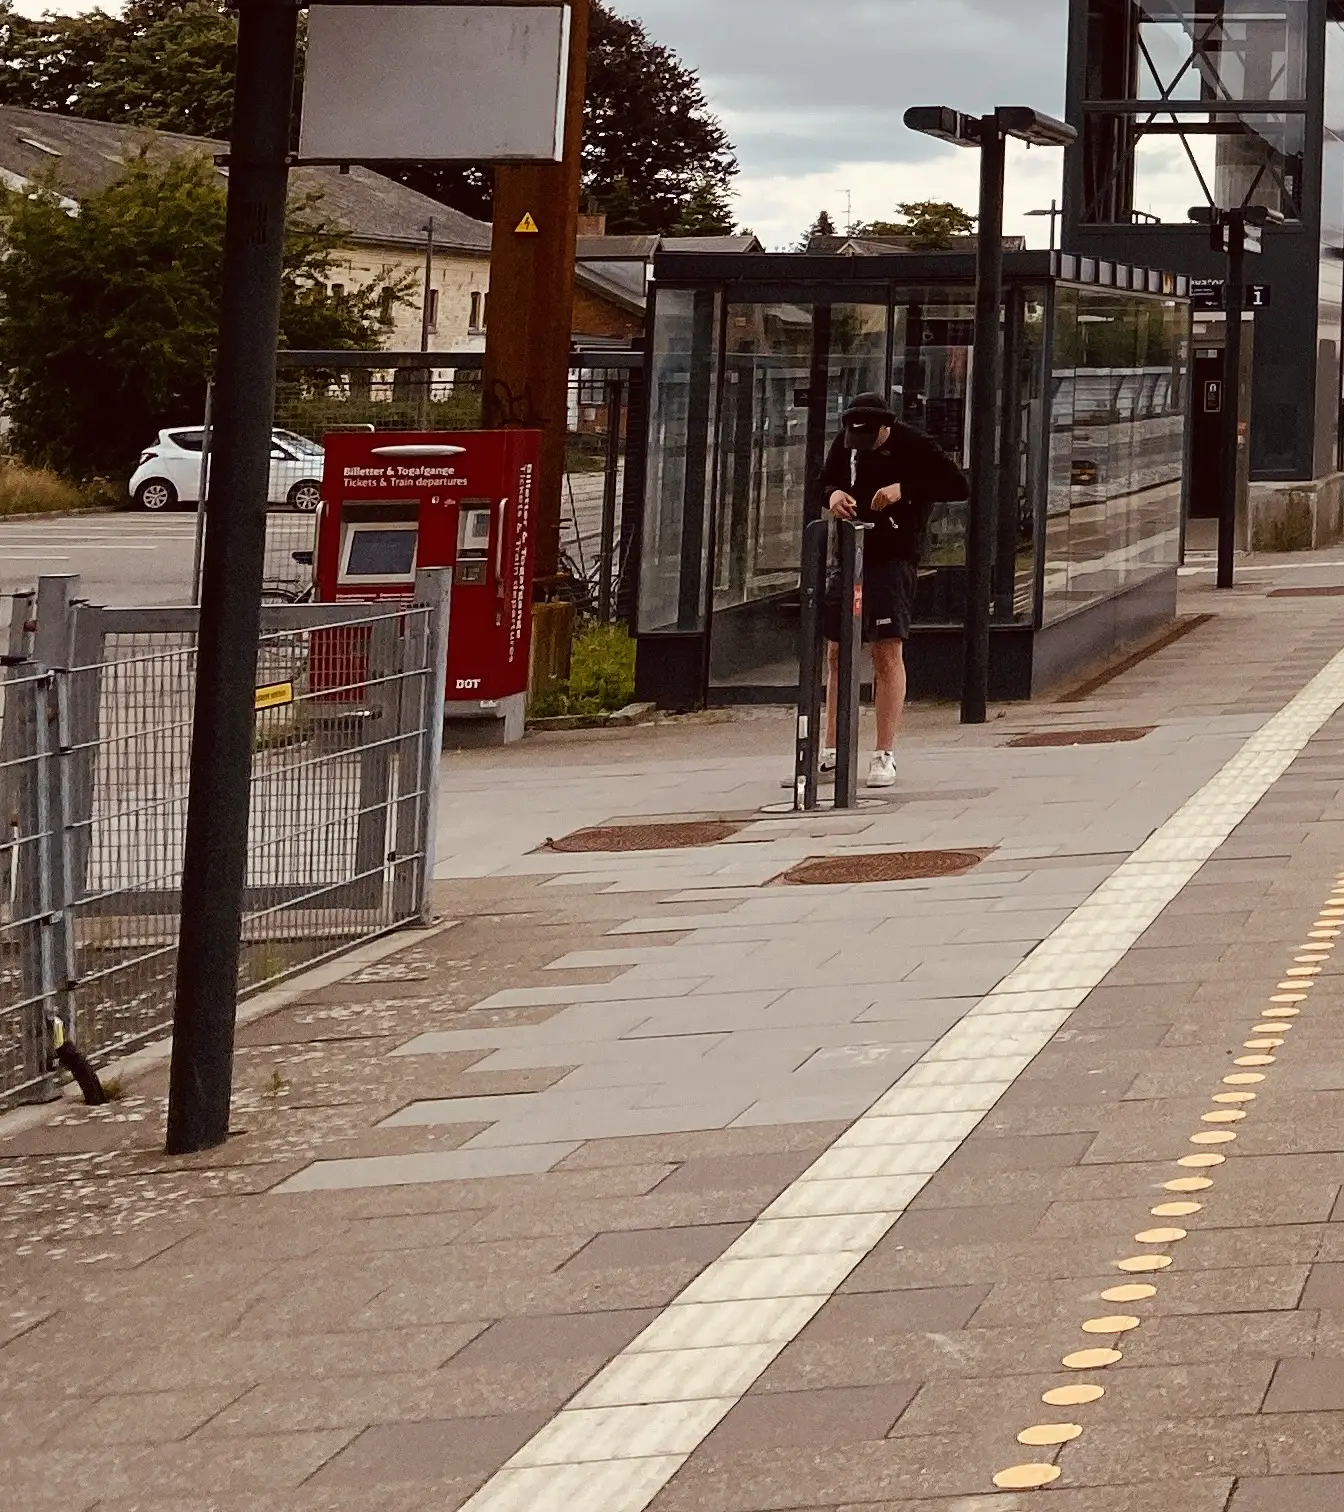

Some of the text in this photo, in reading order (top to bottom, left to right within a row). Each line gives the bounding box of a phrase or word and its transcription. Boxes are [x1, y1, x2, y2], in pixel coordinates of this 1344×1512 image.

[1252, 291, 1263, 305] 1
[343, 467, 385, 476] Billetter
[386, 466, 395, 476] &
[343, 476, 468, 488] Tickets & Train departures
[456, 678, 481, 689] DOT
